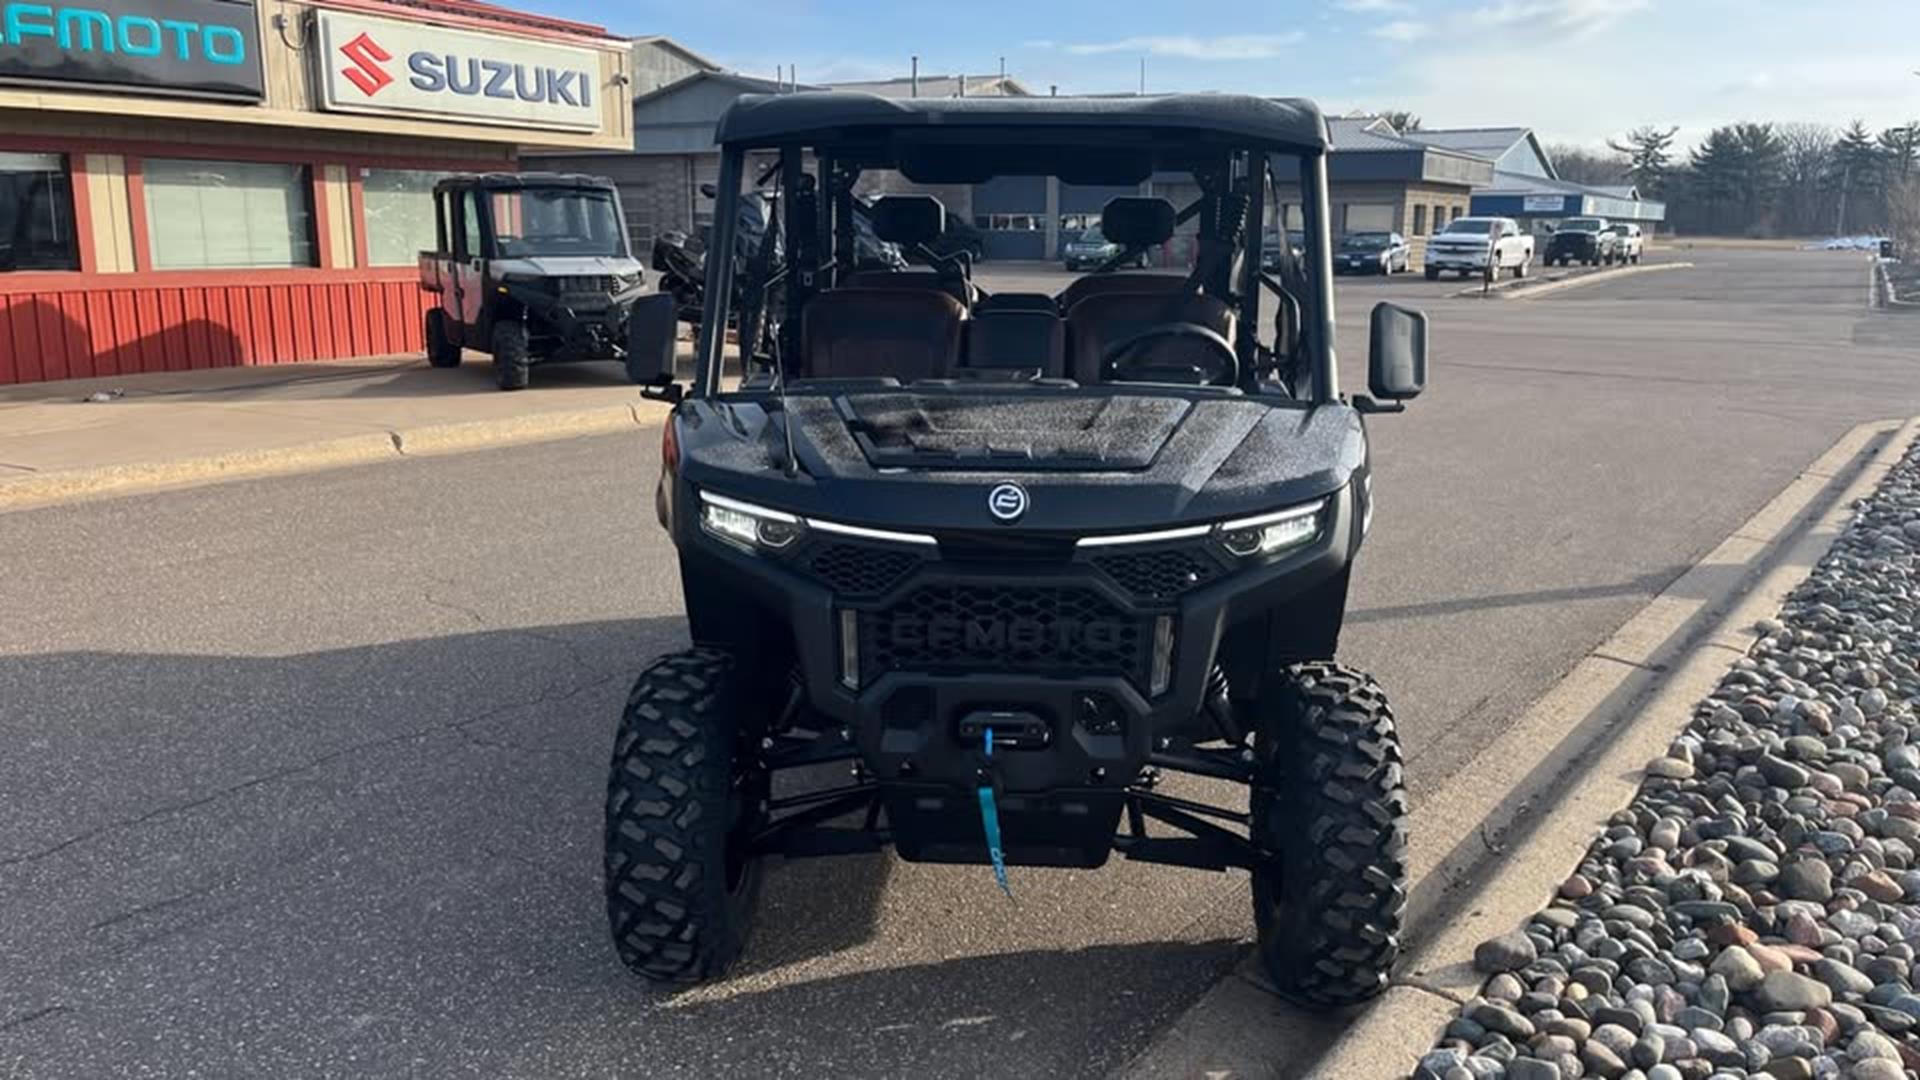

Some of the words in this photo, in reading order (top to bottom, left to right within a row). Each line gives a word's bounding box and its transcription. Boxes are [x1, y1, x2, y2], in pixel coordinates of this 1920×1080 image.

[0, 3, 245, 64] FMOTO
[408, 51, 592, 107] SUZUKI
[892, 617, 1121, 650] CFMOTO
